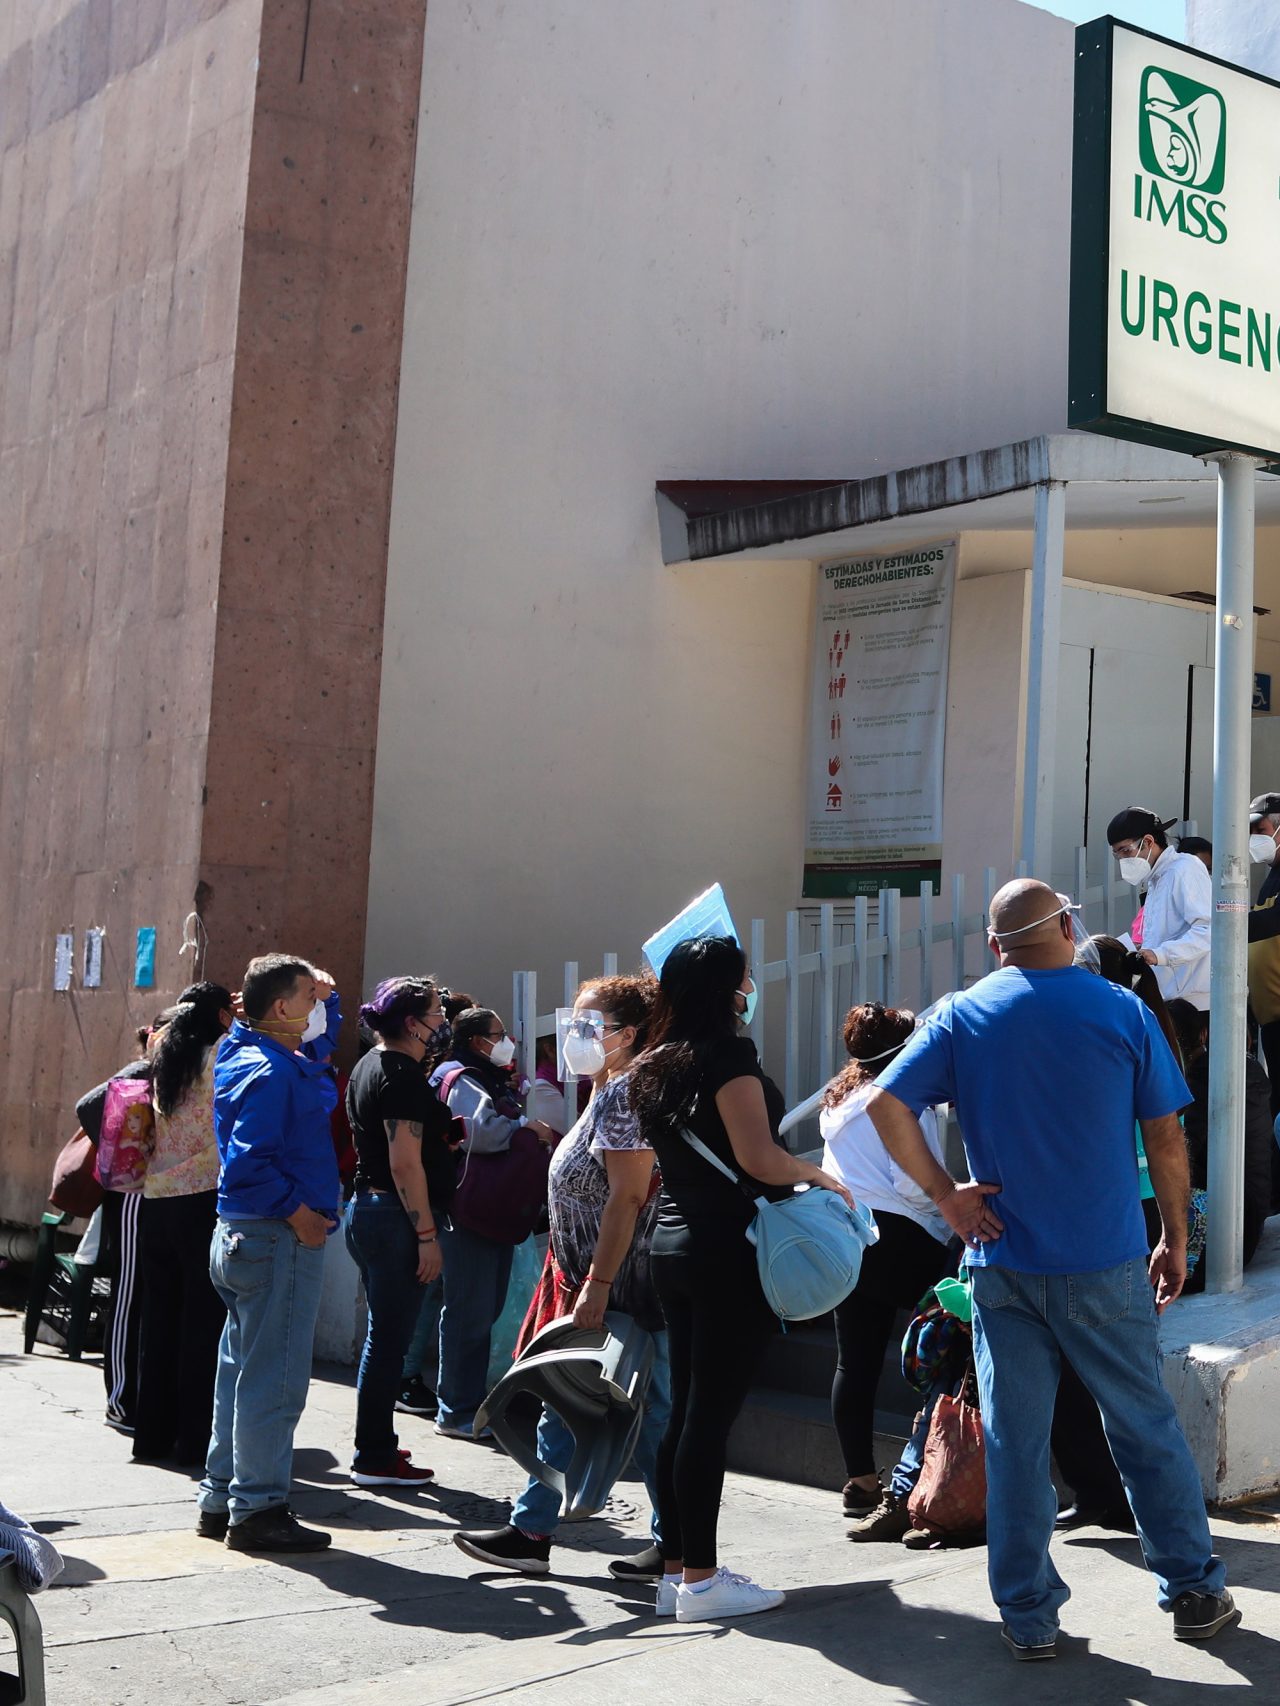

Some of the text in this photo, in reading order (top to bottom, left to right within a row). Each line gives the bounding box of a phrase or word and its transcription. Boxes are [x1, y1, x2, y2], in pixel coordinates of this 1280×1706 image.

[1133, 173, 1228, 245] IMSS
[824, 549, 944, 579] ESTIMADAS Y ESTIMADOS
[833, 564, 934, 590] DERECHOHABIENTES:
